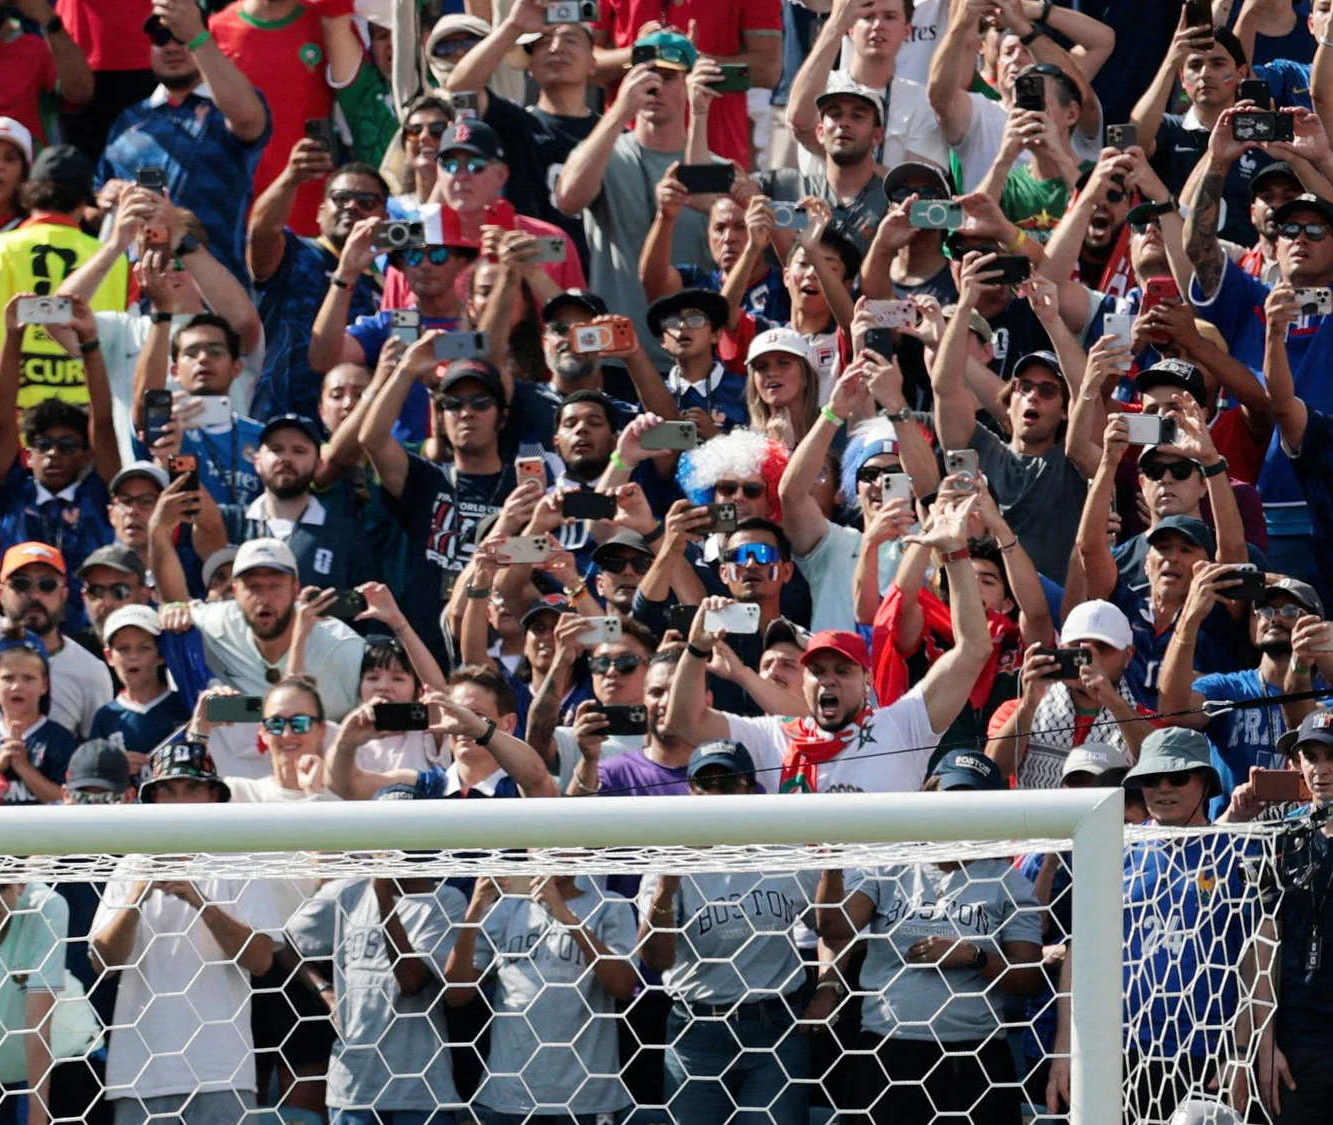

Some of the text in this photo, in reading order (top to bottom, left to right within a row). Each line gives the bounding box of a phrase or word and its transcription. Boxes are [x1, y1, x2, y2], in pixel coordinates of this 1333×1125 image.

[955, 756, 992, 773] BOSTON
[696, 890, 795, 936] BOSTON
[1142, 914, 1184, 955] 24
